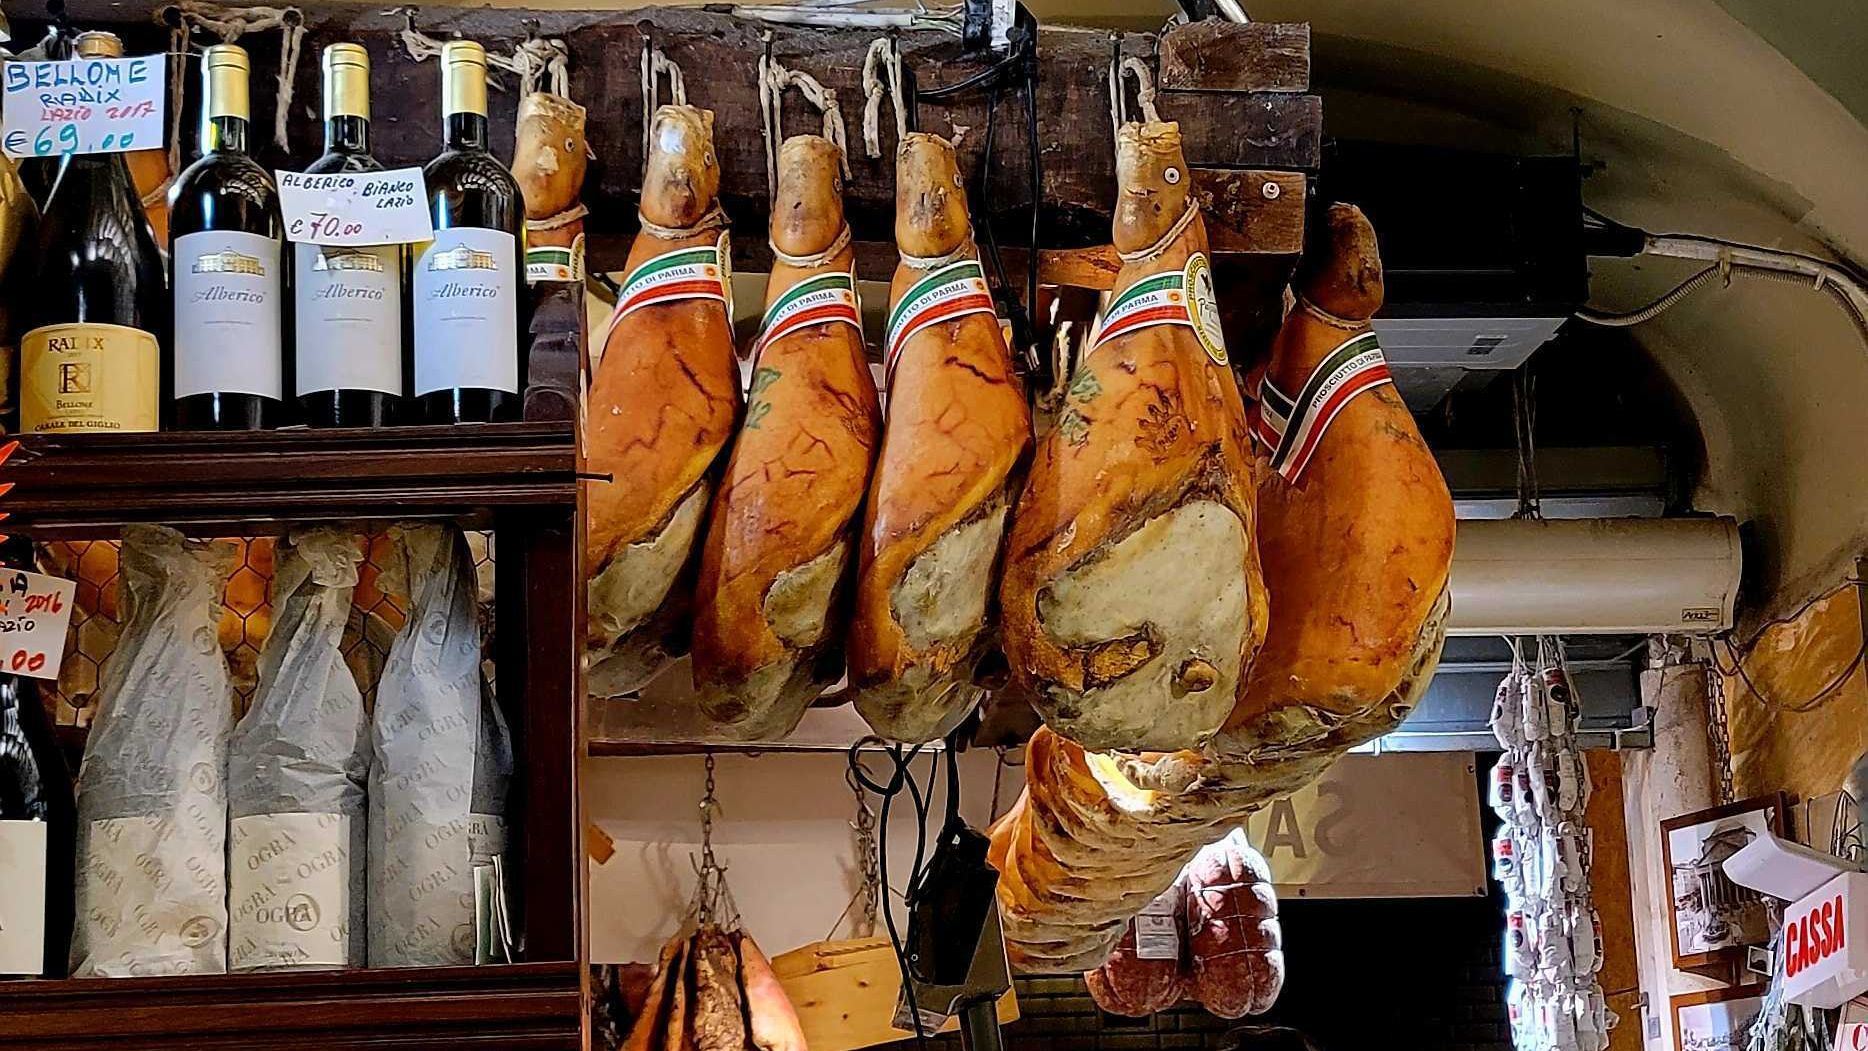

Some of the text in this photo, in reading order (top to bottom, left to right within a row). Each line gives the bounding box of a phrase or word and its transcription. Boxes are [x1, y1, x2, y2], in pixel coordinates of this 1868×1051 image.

[105, 101, 157, 119] 2017
[658, 266, 696, 281] PARMA
[190, 284, 267, 305] Alberico
[311, 283, 386, 302] Alberico
[426, 282, 500, 301] Alberico
[798, 292, 836, 306] PARMA
[920, 295, 932, 305] DI
[932, 282, 969, 300] PARMA
[1121, 294, 1160, 313] PARMA
[1312, 361, 1358, 409] PROSCIUTTO
[34, 420, 121, 433] CASALE DEL GIGLIO
[25, 591, 63, 614] 2016
[247, 829, 297, 871] OGRA
[297, 843, 347, 880] OGRA
[409, 860, 457, 903] OGRA
[233, 883, 277, 924] OGRA
[1786, 894, 1845, 979] CASSA
